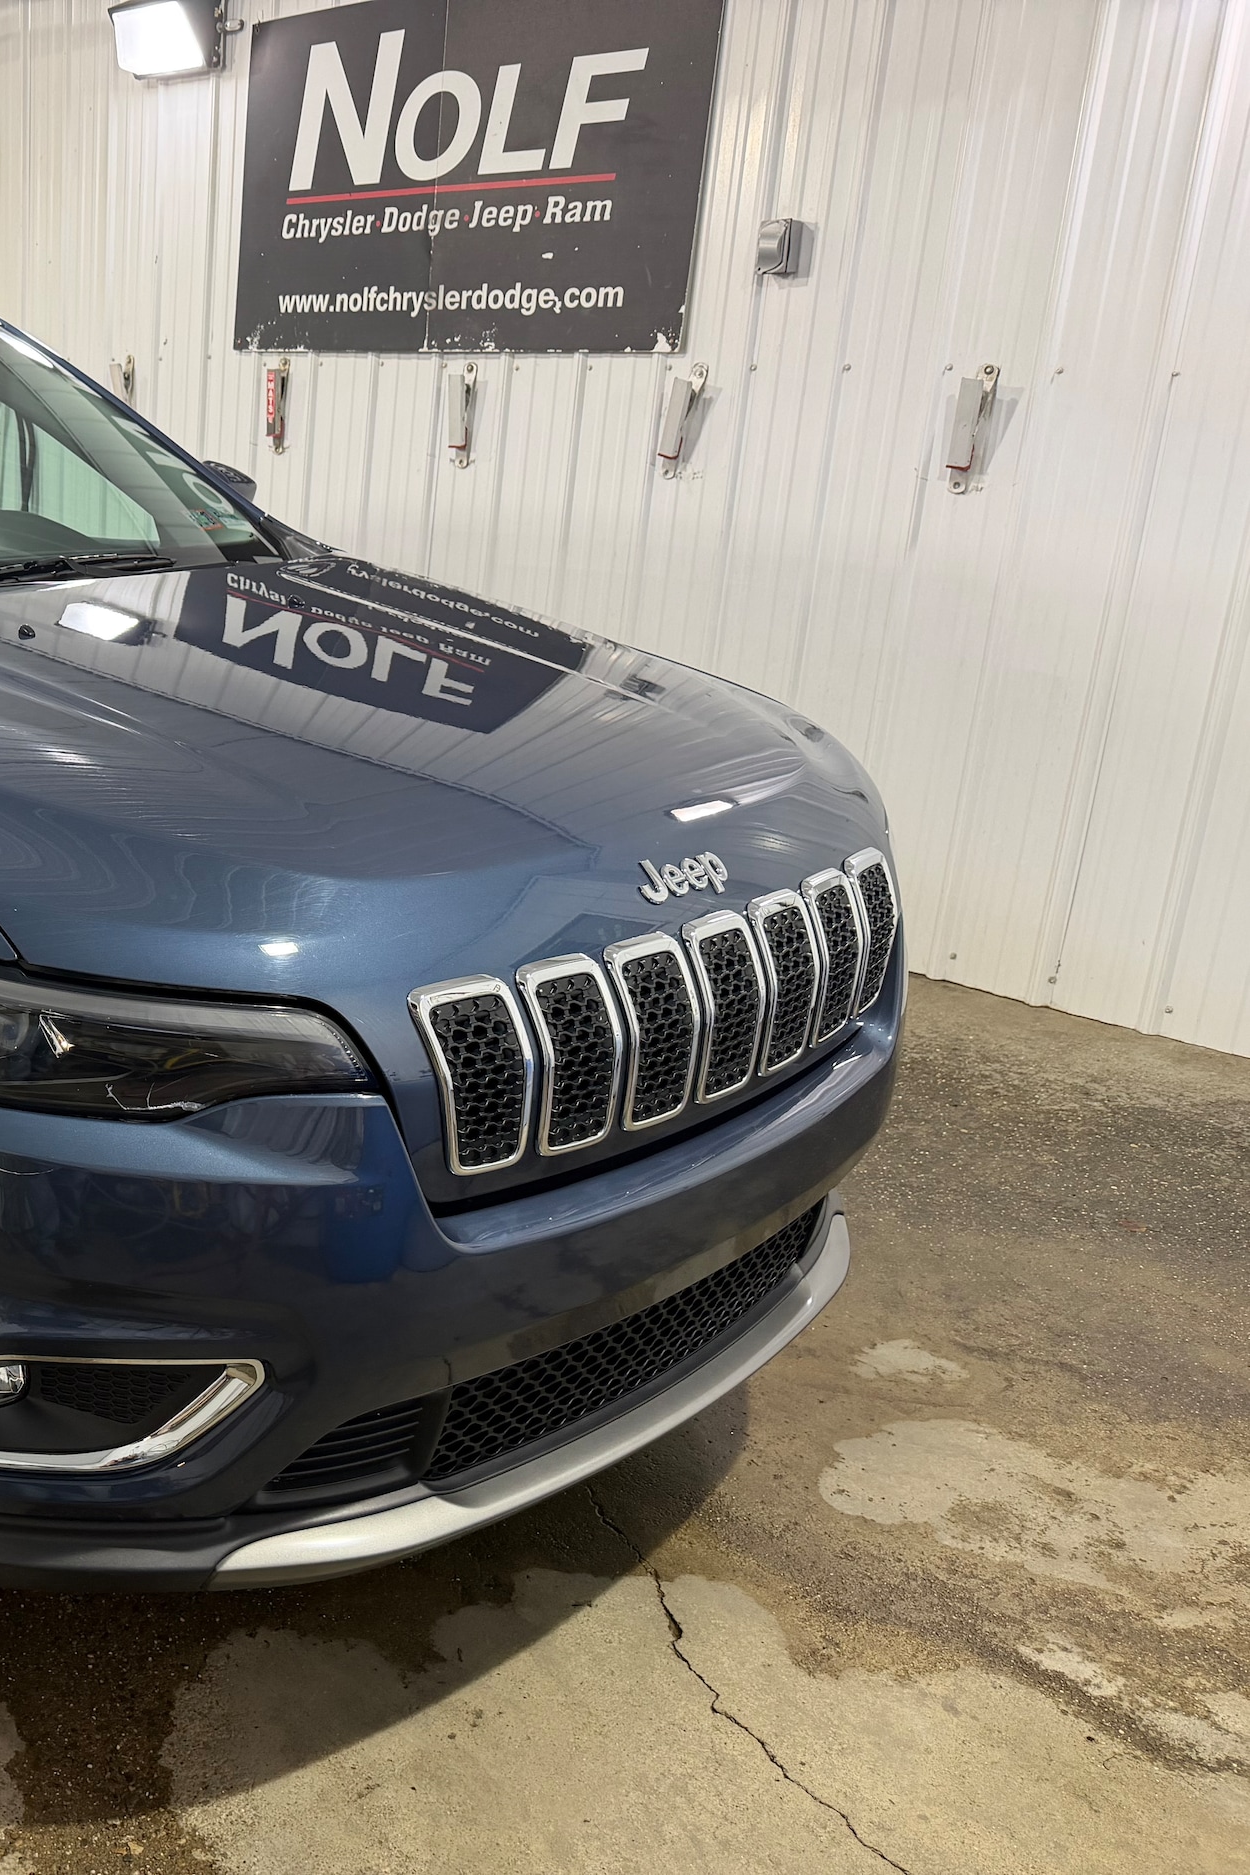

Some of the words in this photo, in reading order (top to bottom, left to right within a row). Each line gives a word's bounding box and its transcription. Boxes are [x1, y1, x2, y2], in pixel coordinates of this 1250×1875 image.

[289, 28, 649, 191] NOLF
[281, 209, 375, 243] Chrysler
[380, 203, 461, 236] Dodge
[468, 200, 533, 232] Jeep
[543, 195, 613, 225] Ram
[278, 282, 625, 317] www.nolfchryslerdodge.com
[638, 851, 728, 905] Jeep
